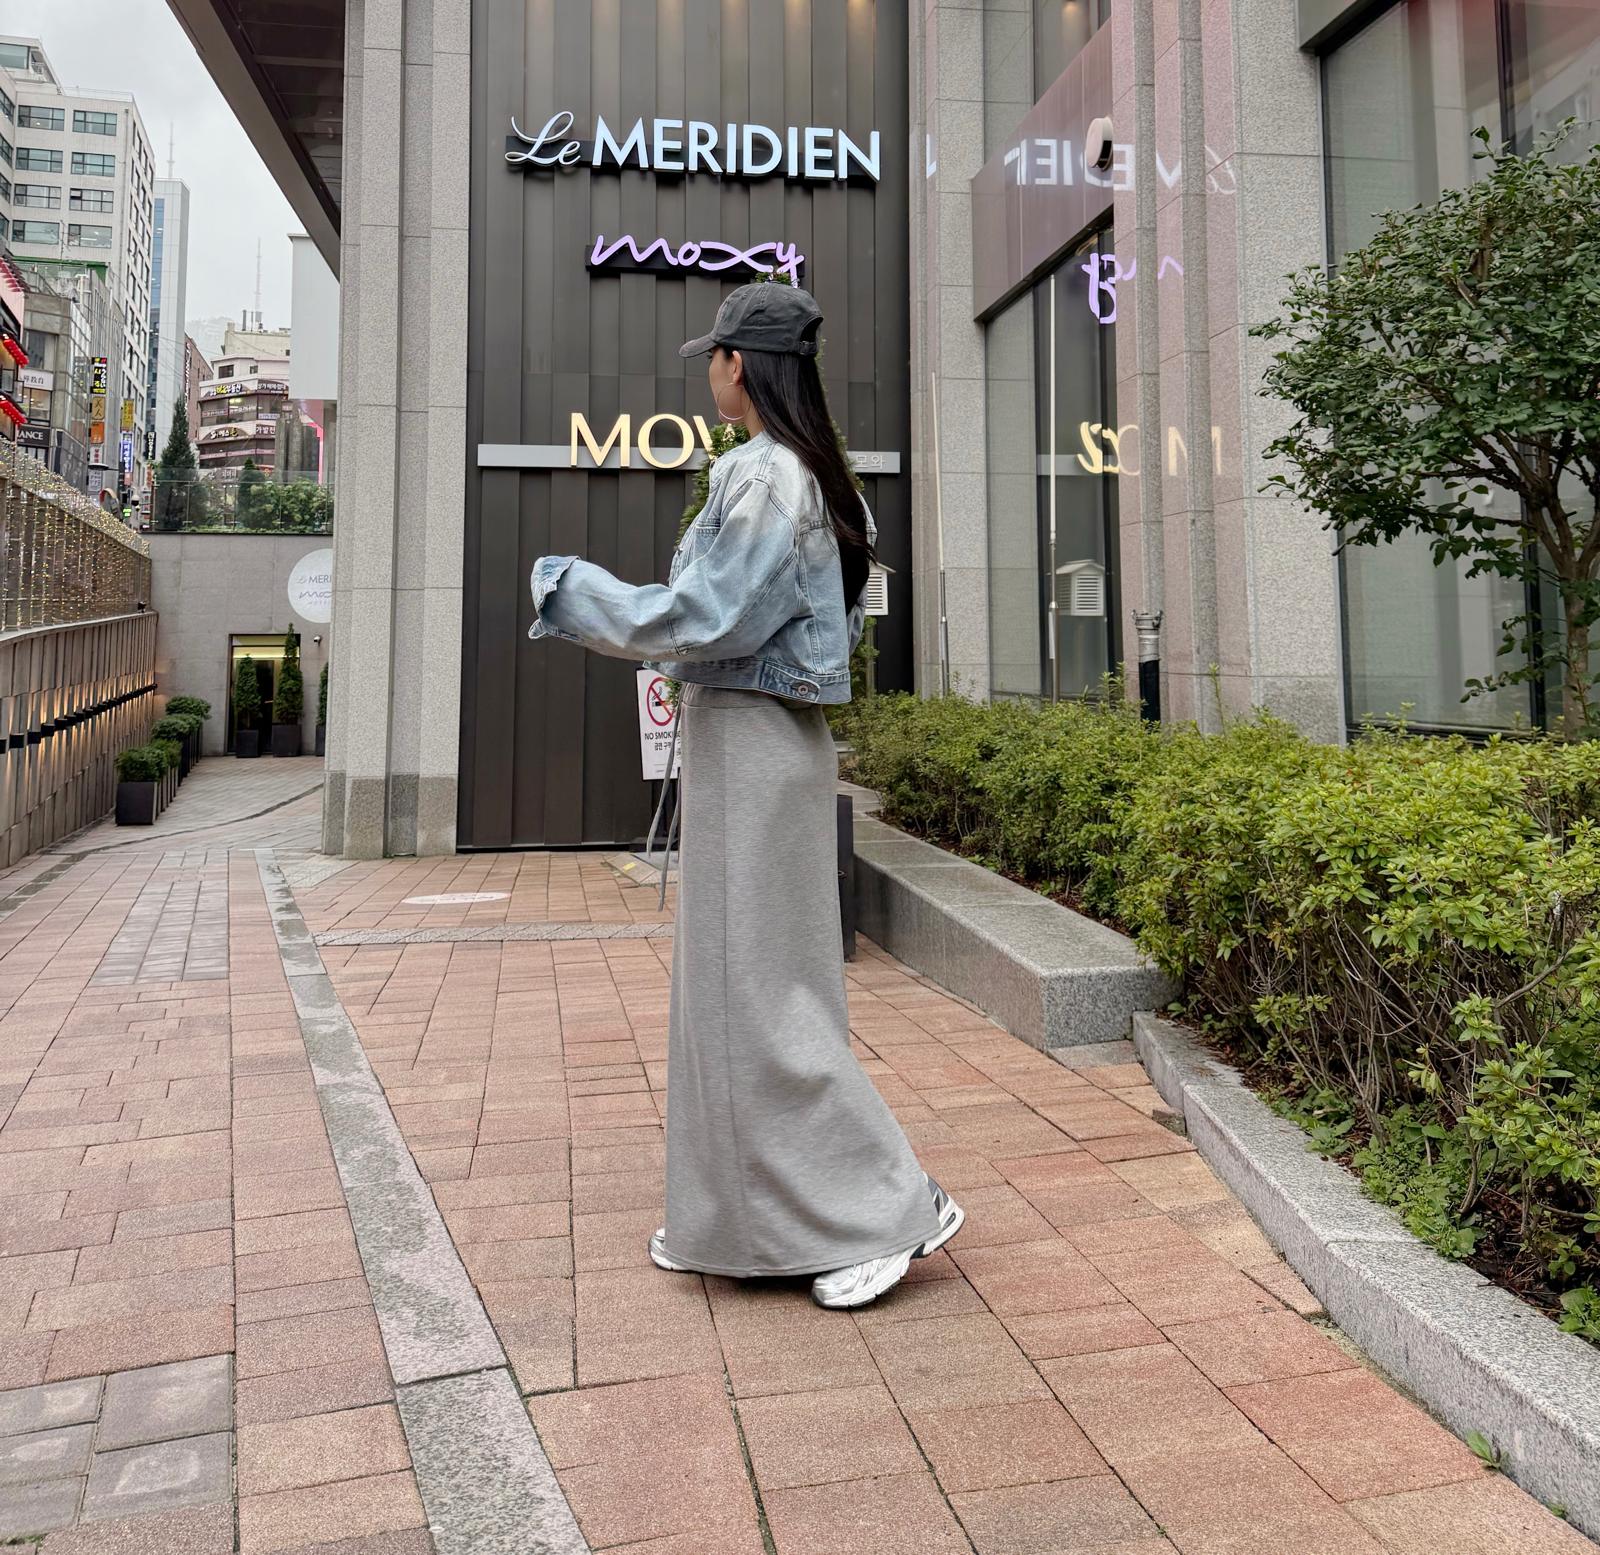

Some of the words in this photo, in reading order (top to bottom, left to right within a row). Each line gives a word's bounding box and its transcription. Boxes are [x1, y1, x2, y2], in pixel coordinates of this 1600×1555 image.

[504, 111, 581, 166] Le
[592, 114, 881, 182] MERIDIEN
[591, 235, 804, 287] moxy
[18, 430, 44, 441] ANCE
[570, 412, 716, 469] MO
[855, 454, 884, 469] 모와
[308, 574, 332, 584] MERI
[644, 732, 654, 740] NO
